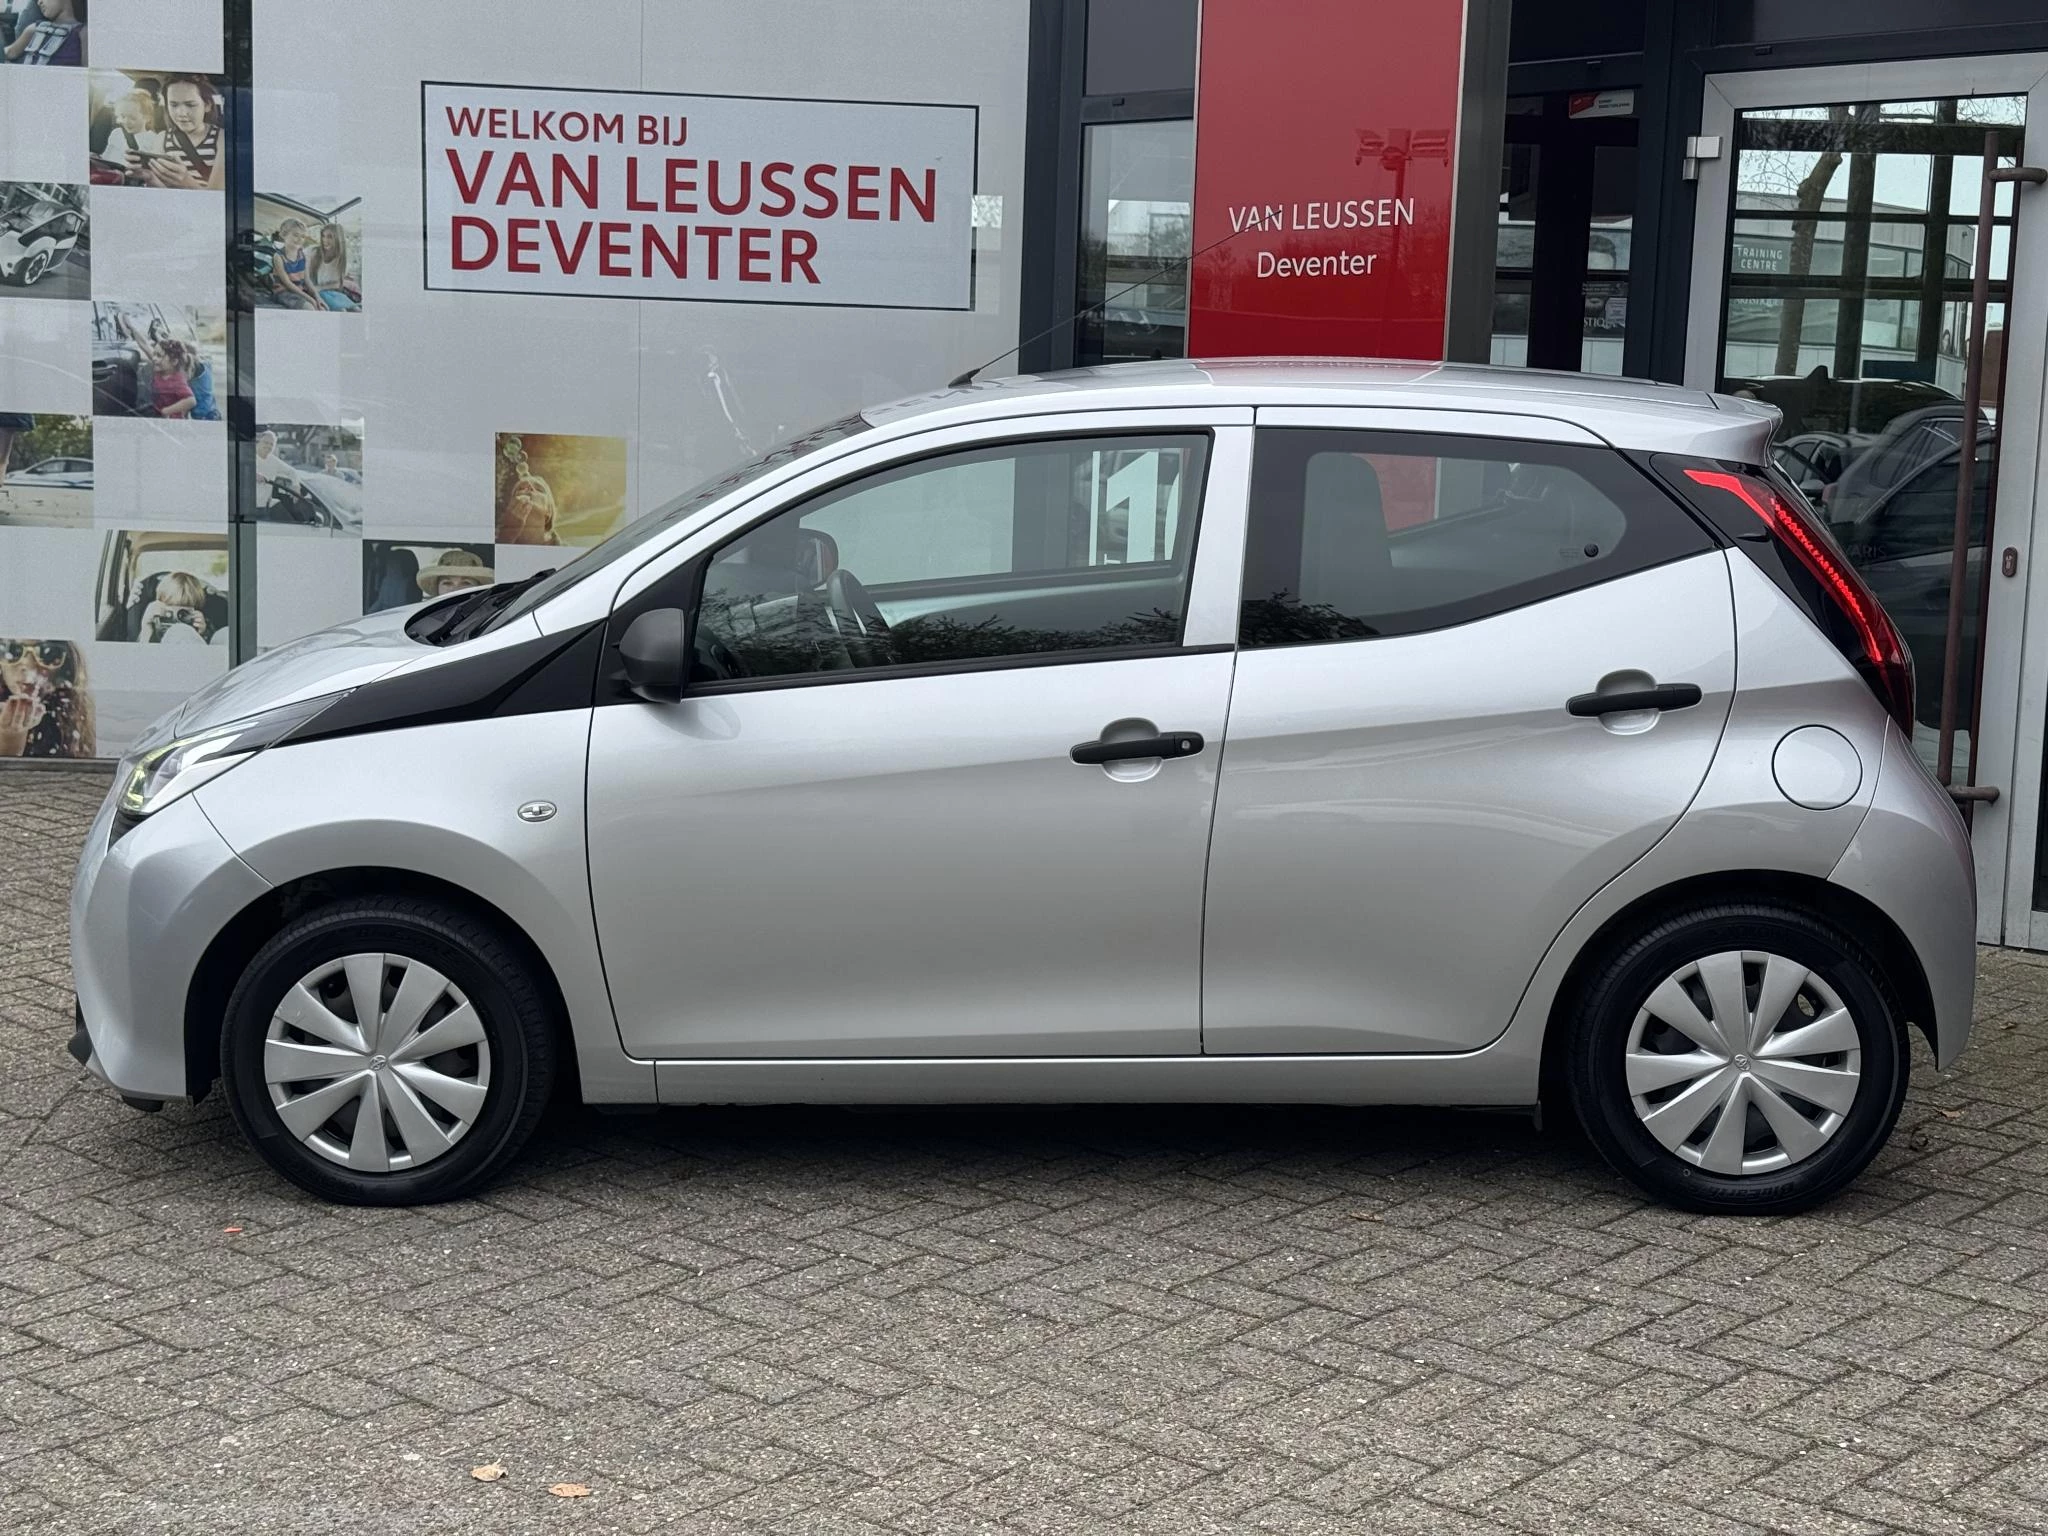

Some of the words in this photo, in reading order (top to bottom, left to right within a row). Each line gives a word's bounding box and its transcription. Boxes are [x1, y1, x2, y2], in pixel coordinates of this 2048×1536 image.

[445, 106, 624, 144] WELKOM
[638, 114, 688, 146] BIJ
[445, 148, 599, 210] VAN
[627, 156, 936, 223] LEUSSEN
[1228, 204, 1284, 233] VAN
[1292, 198, 1414, 230] LEUSSEN
[451, 216, 821, 284] DEVENTER
[1257, 250, 1377, 278] Deventer
[1737, 247, 1783, 260] TRAINING
[1740, 259, 1777, 271] CENTRE
